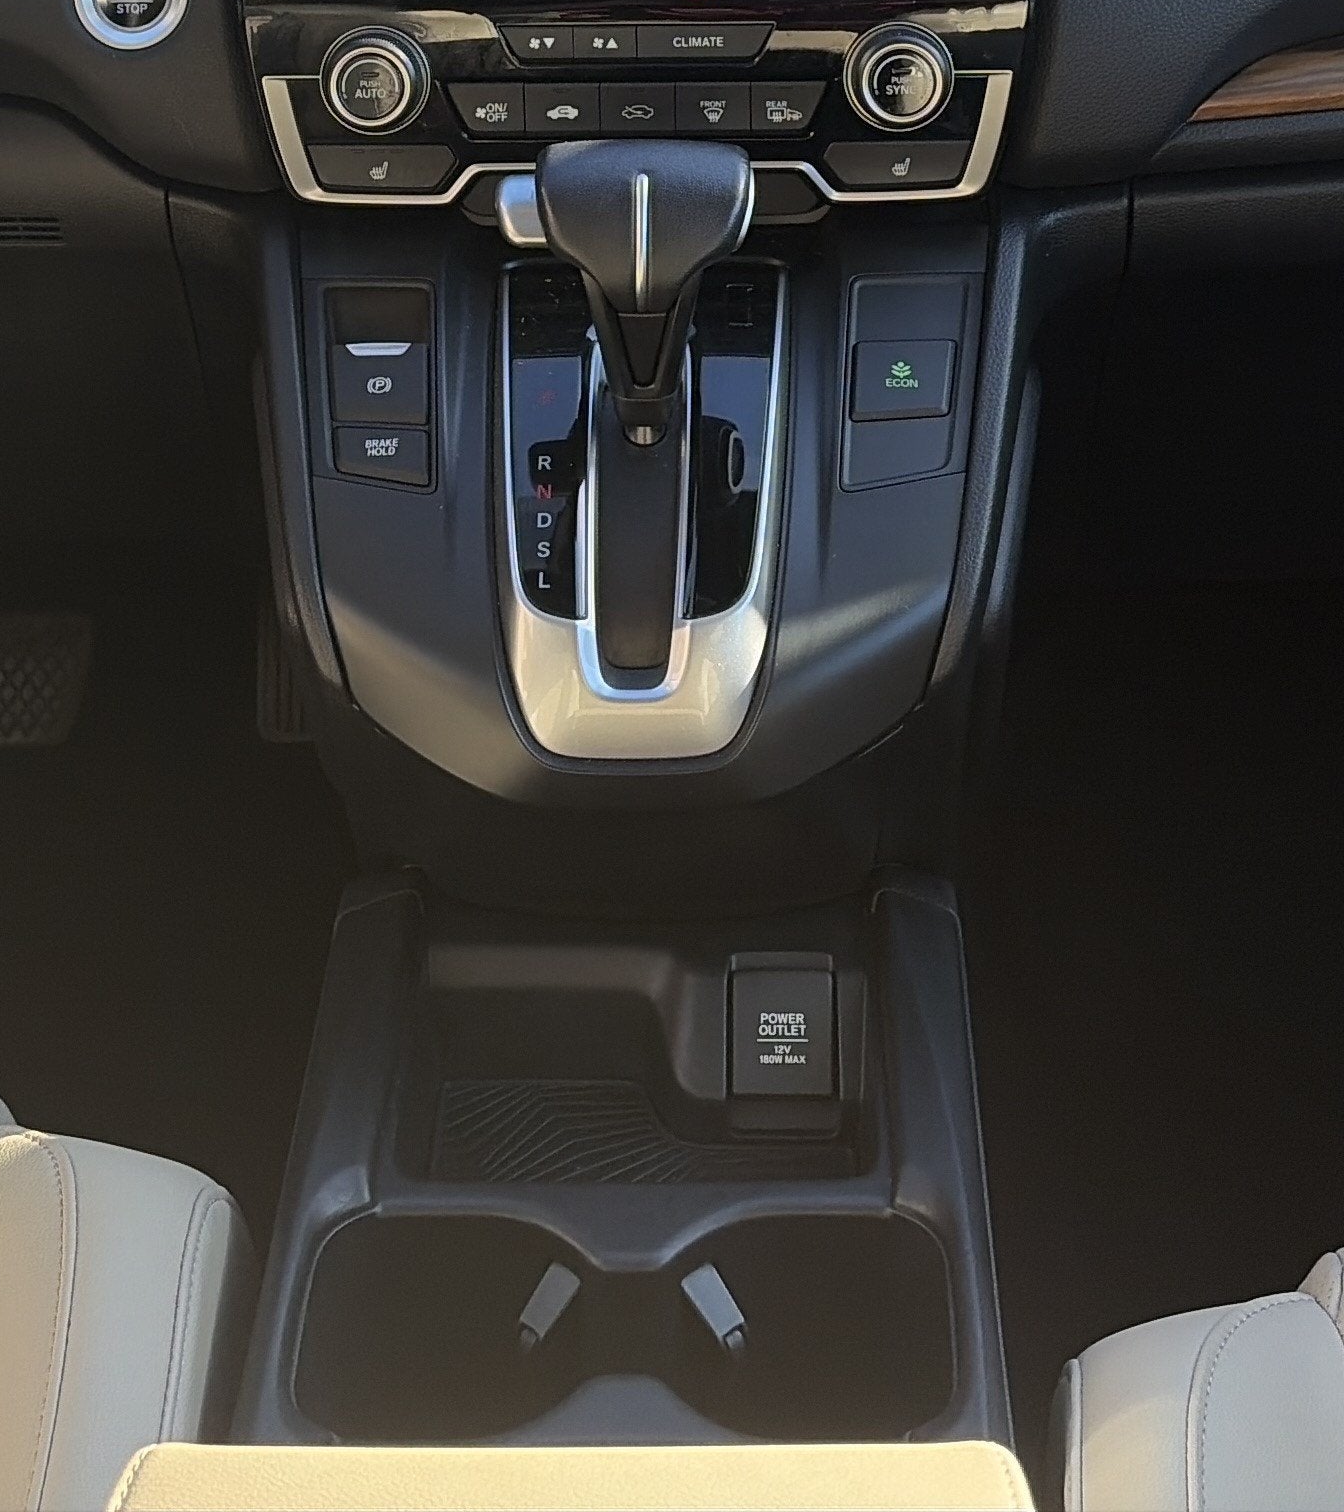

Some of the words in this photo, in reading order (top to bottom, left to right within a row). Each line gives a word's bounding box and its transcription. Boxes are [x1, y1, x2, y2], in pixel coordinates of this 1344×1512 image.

[116, 3, 149, 15] STOP
[673, 37, 724, 48] CLIMATE
[359, 80, 381, 88] PUSH
[355, 88, 386, 99] AUTO
[486, 103, 508, 113] ON/
[766, 100, 788, 108] REAR
[486, 112, 508, 123] OFF
[885, 378, 919, 388] ECON
[365, 438, 399, 448] BRAKE
[367, 447, 396, 456] HOLD
[537, 455, 552, 471] R
[537, 484, 552, 499] N
[537, 512, 553, 528] D
[537, 541, 551, 558] S
[538, 571, 551, 589] L
[760, 1013, 805, 1024] POWER
[758, 1024, 807, 1036] OUTLET
[774, 1045, 792, 1054] 12V
[759, 1055, 783, 1064] 180W
[785, 1055, 806, 1064] MAX
